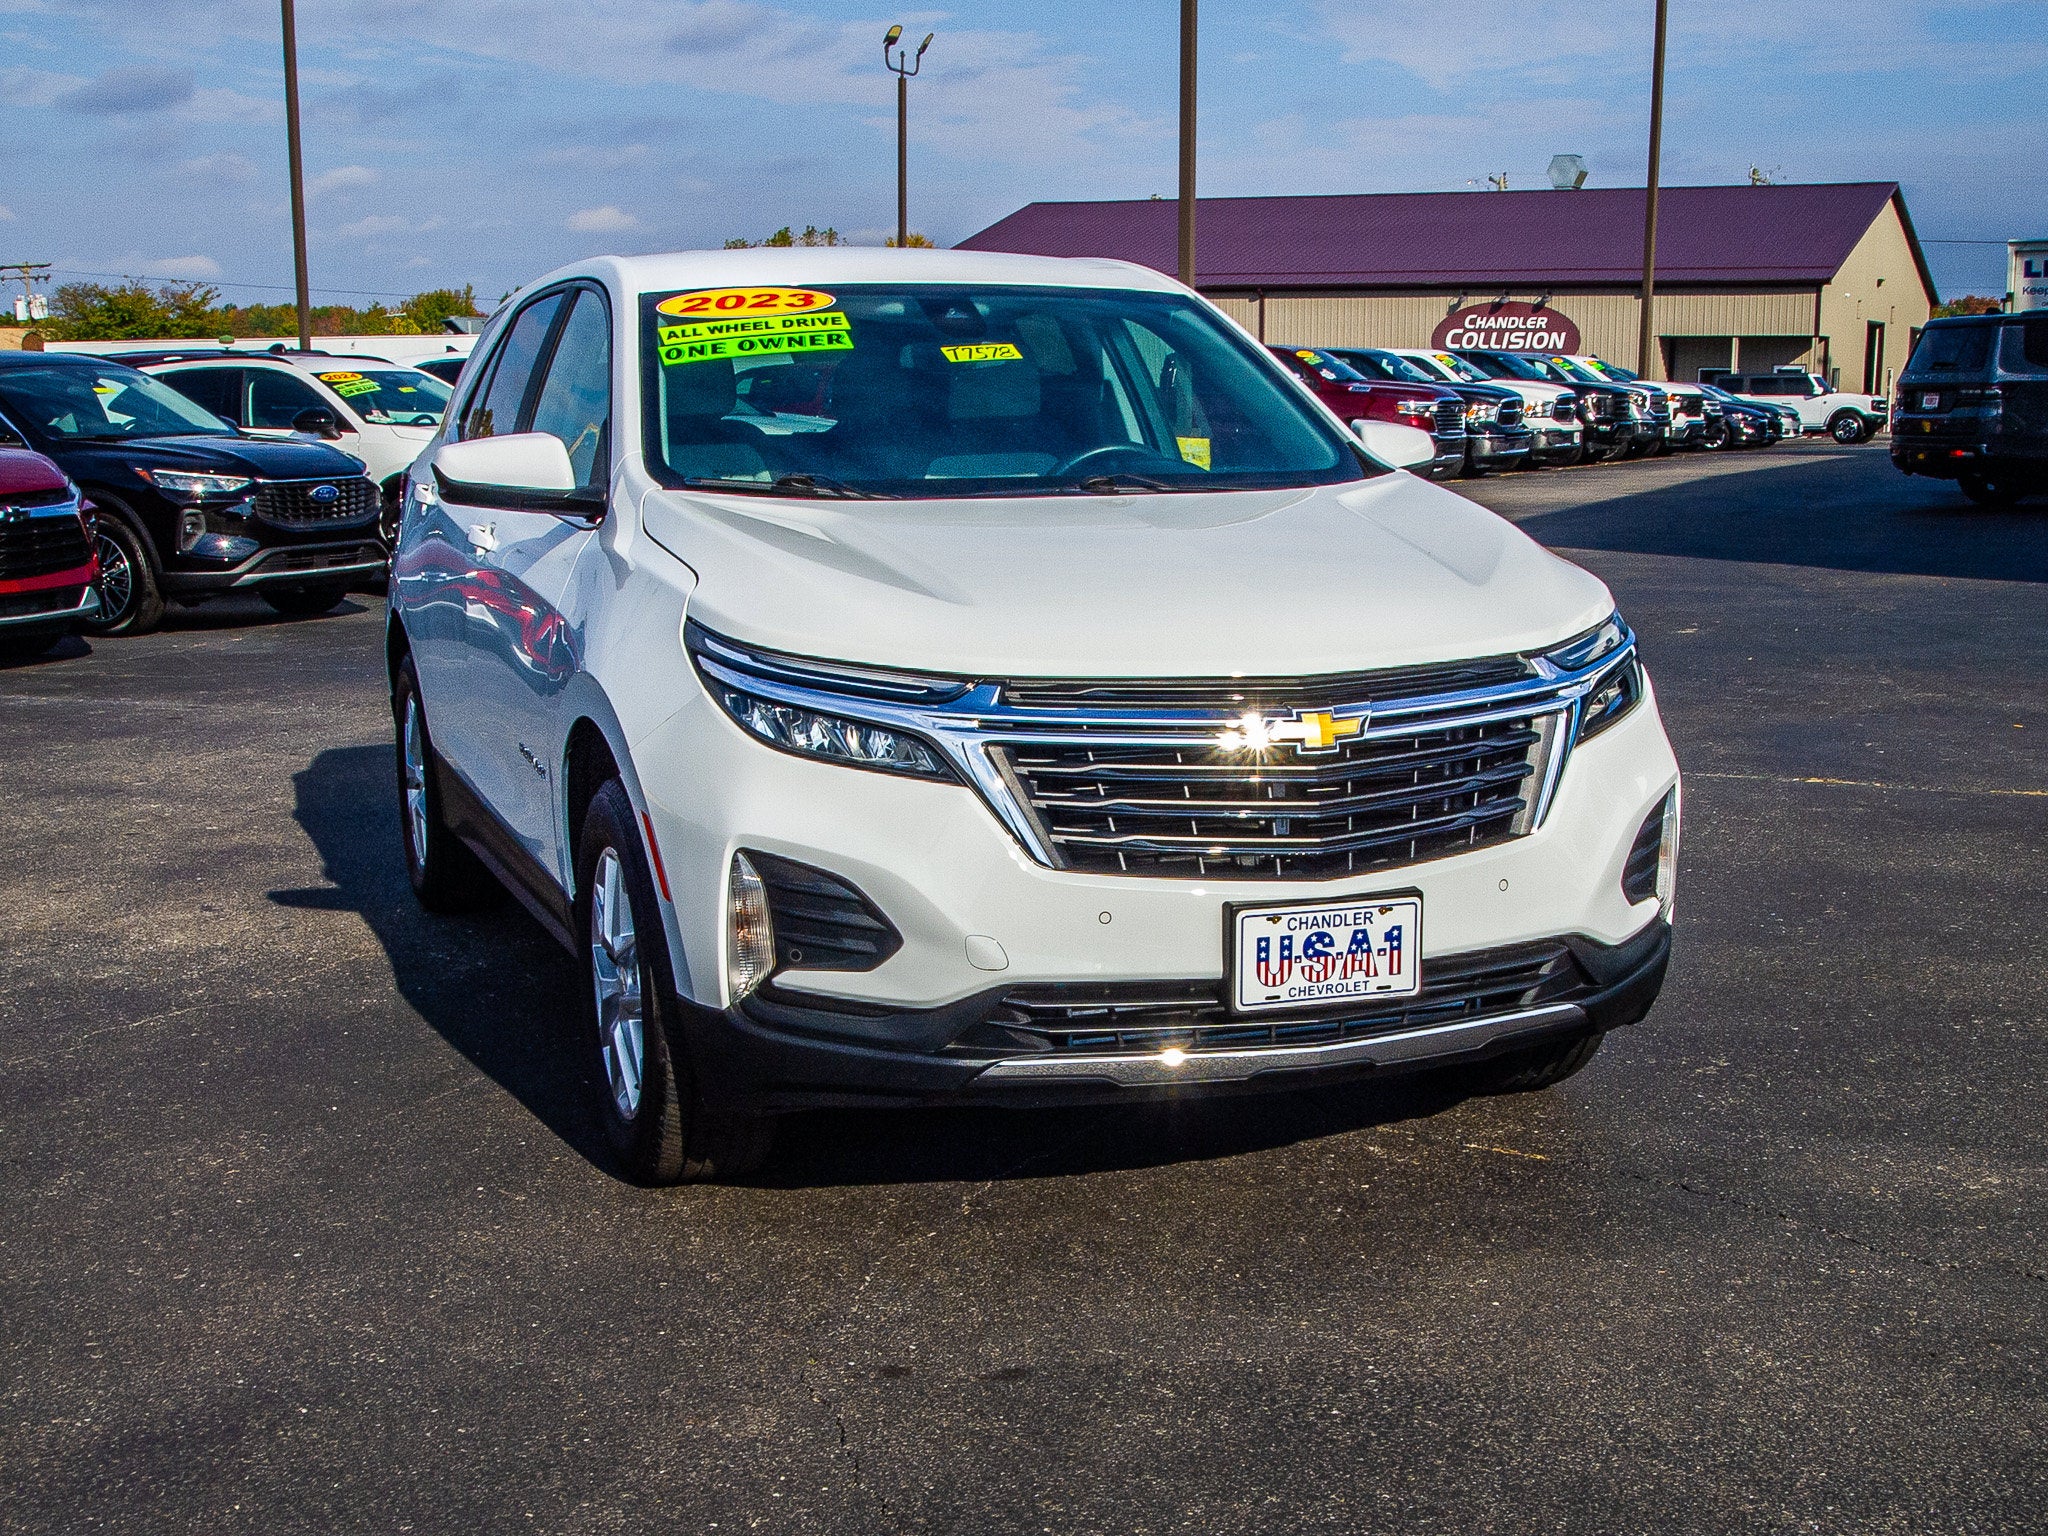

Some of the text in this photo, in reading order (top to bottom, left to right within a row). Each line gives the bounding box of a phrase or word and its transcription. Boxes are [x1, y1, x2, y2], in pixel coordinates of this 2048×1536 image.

[678, 293, 815, 313] 2023
[666, 316, 843, 340] ALL WHEEL DRIVE
[1464, 314, 1548, 329] CHANDLER
[665, 333, 847, 361] ONE OWNER
[1445, 328, 1567, 350] COLLISION
[325, 373, 358, 381] 2024
[1287, 911, 1374, 931] CHANDLER
[1288, 980, 1370, 998] CHEVROLET
